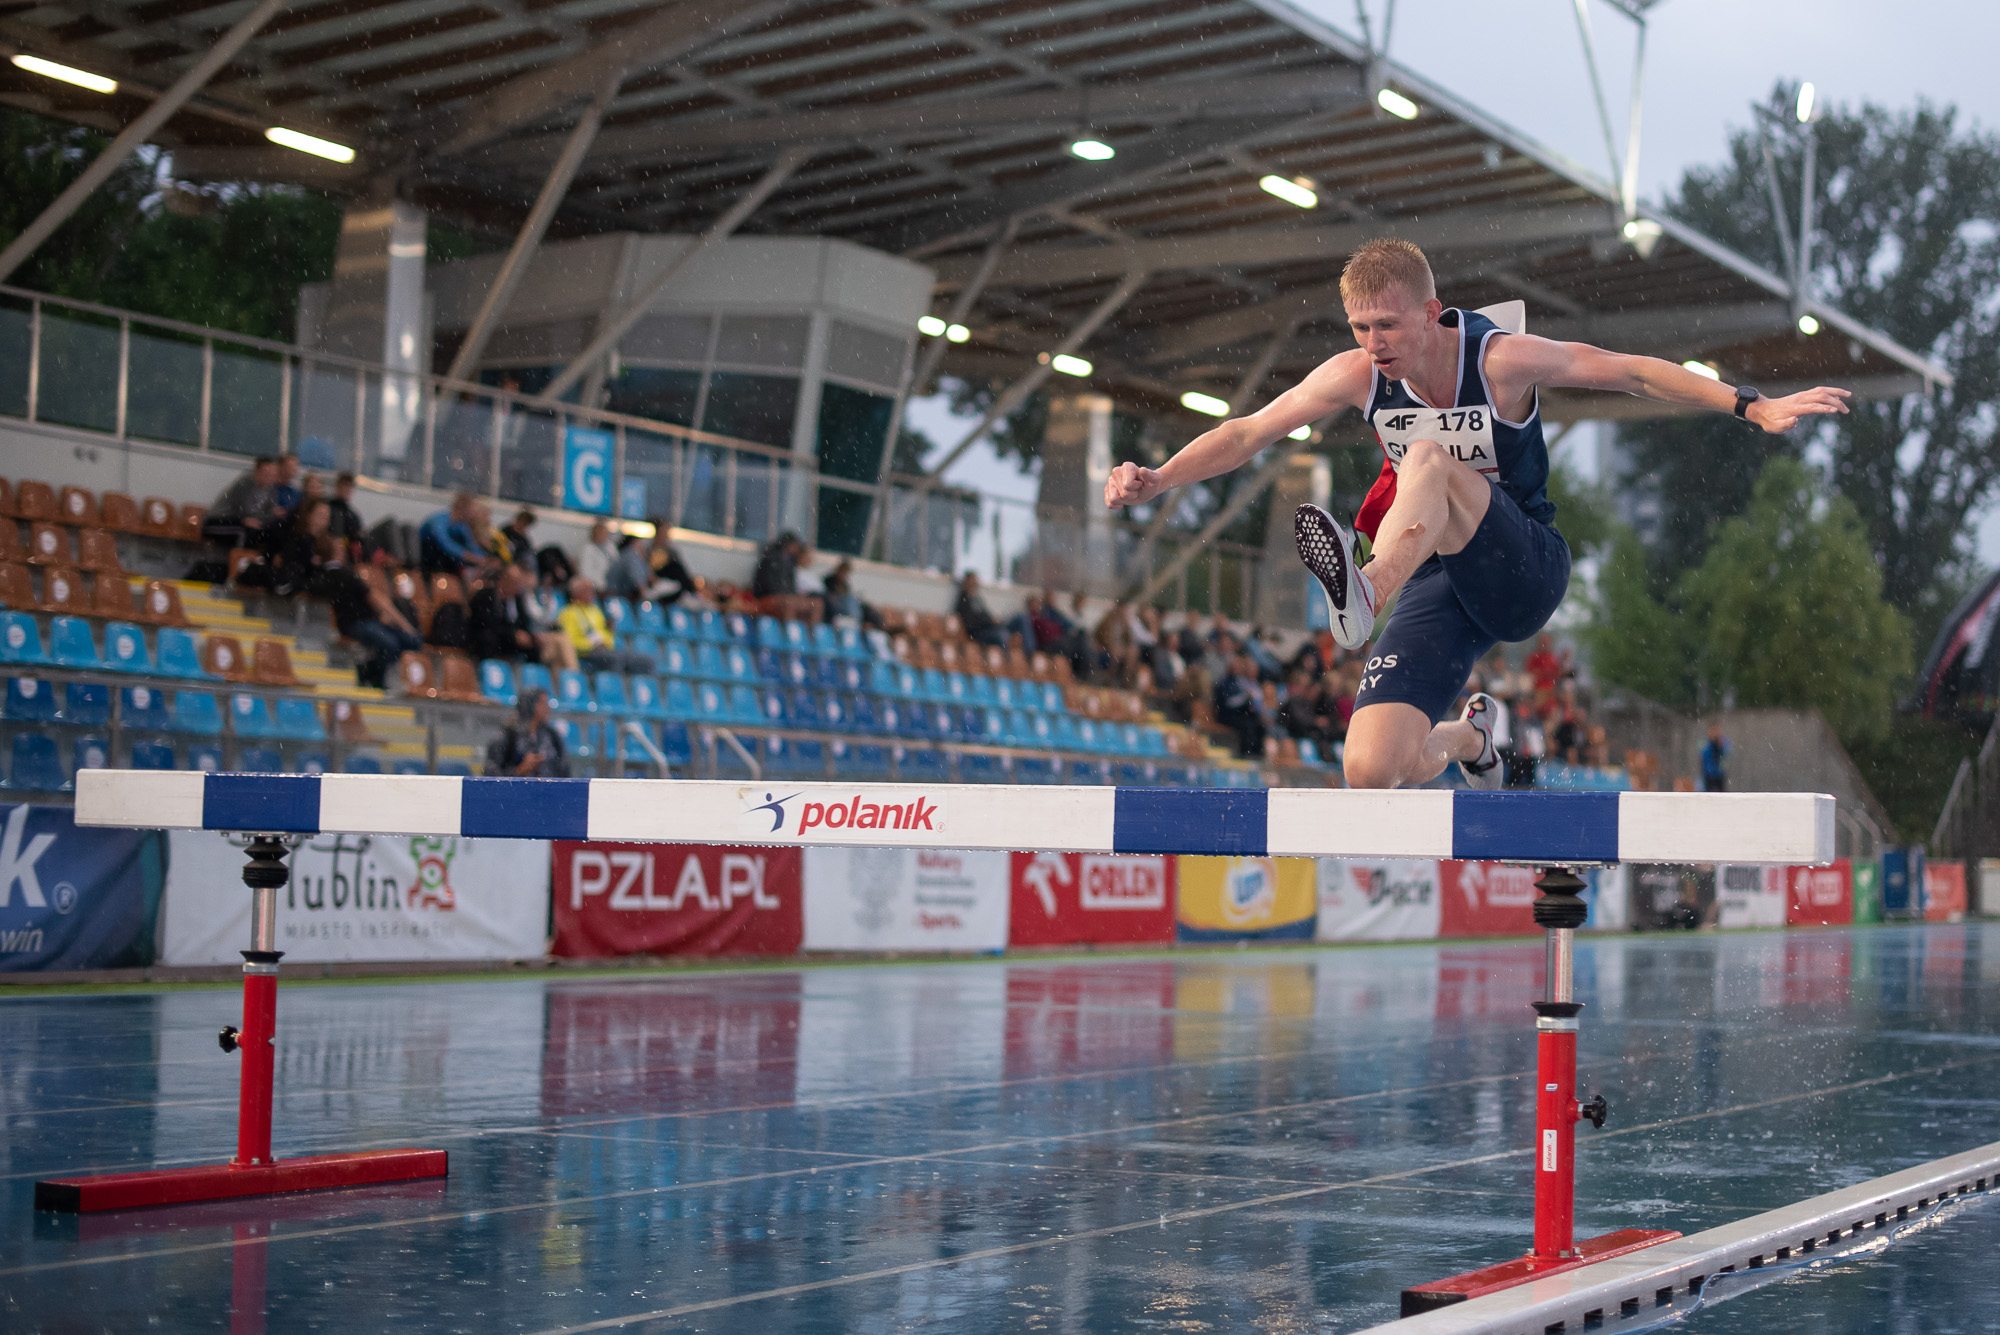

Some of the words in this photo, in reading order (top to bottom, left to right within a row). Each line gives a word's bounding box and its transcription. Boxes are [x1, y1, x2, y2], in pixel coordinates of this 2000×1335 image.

[1437, 410, 1484, 432] 178
[572, 451, 604, 507] G
[797, 795, 938, 836] polanik
[570, 850, 781, 911] PZLA.PL
